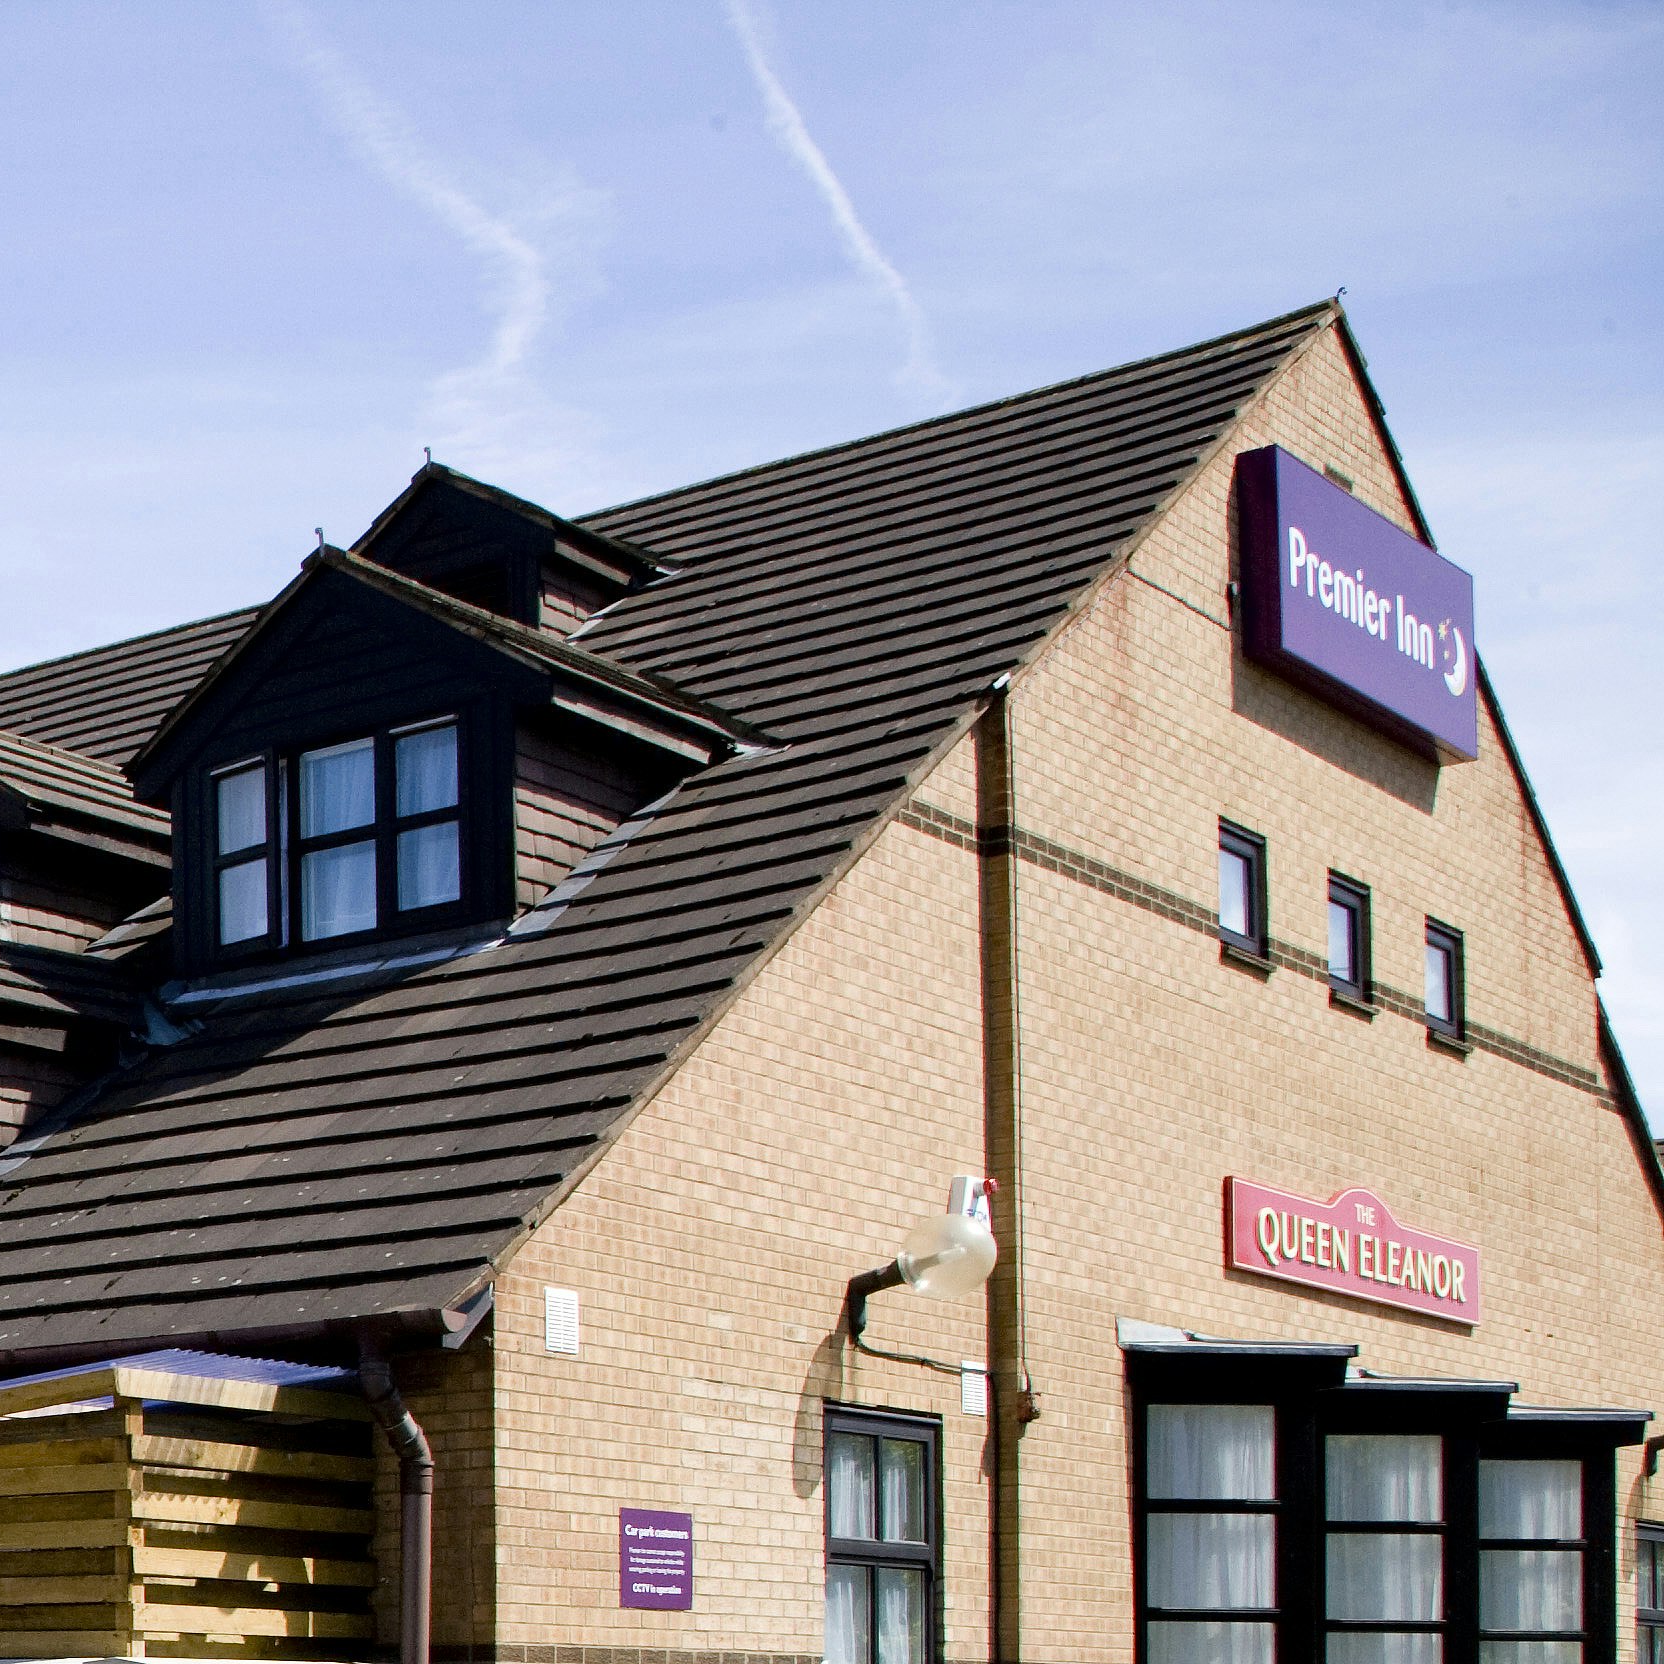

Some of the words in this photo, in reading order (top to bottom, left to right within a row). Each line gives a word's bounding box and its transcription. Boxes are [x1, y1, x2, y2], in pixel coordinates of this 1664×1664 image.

[1288, 526, 1391, 641] Premier
[1396, 595, 1434, 670] Inn
[1257, 1206, 1350, 1272] QUEEN
[1358, 1234, 1467, 1303] ELEANOR
[1354, 1203, 1376, 1227] THE
